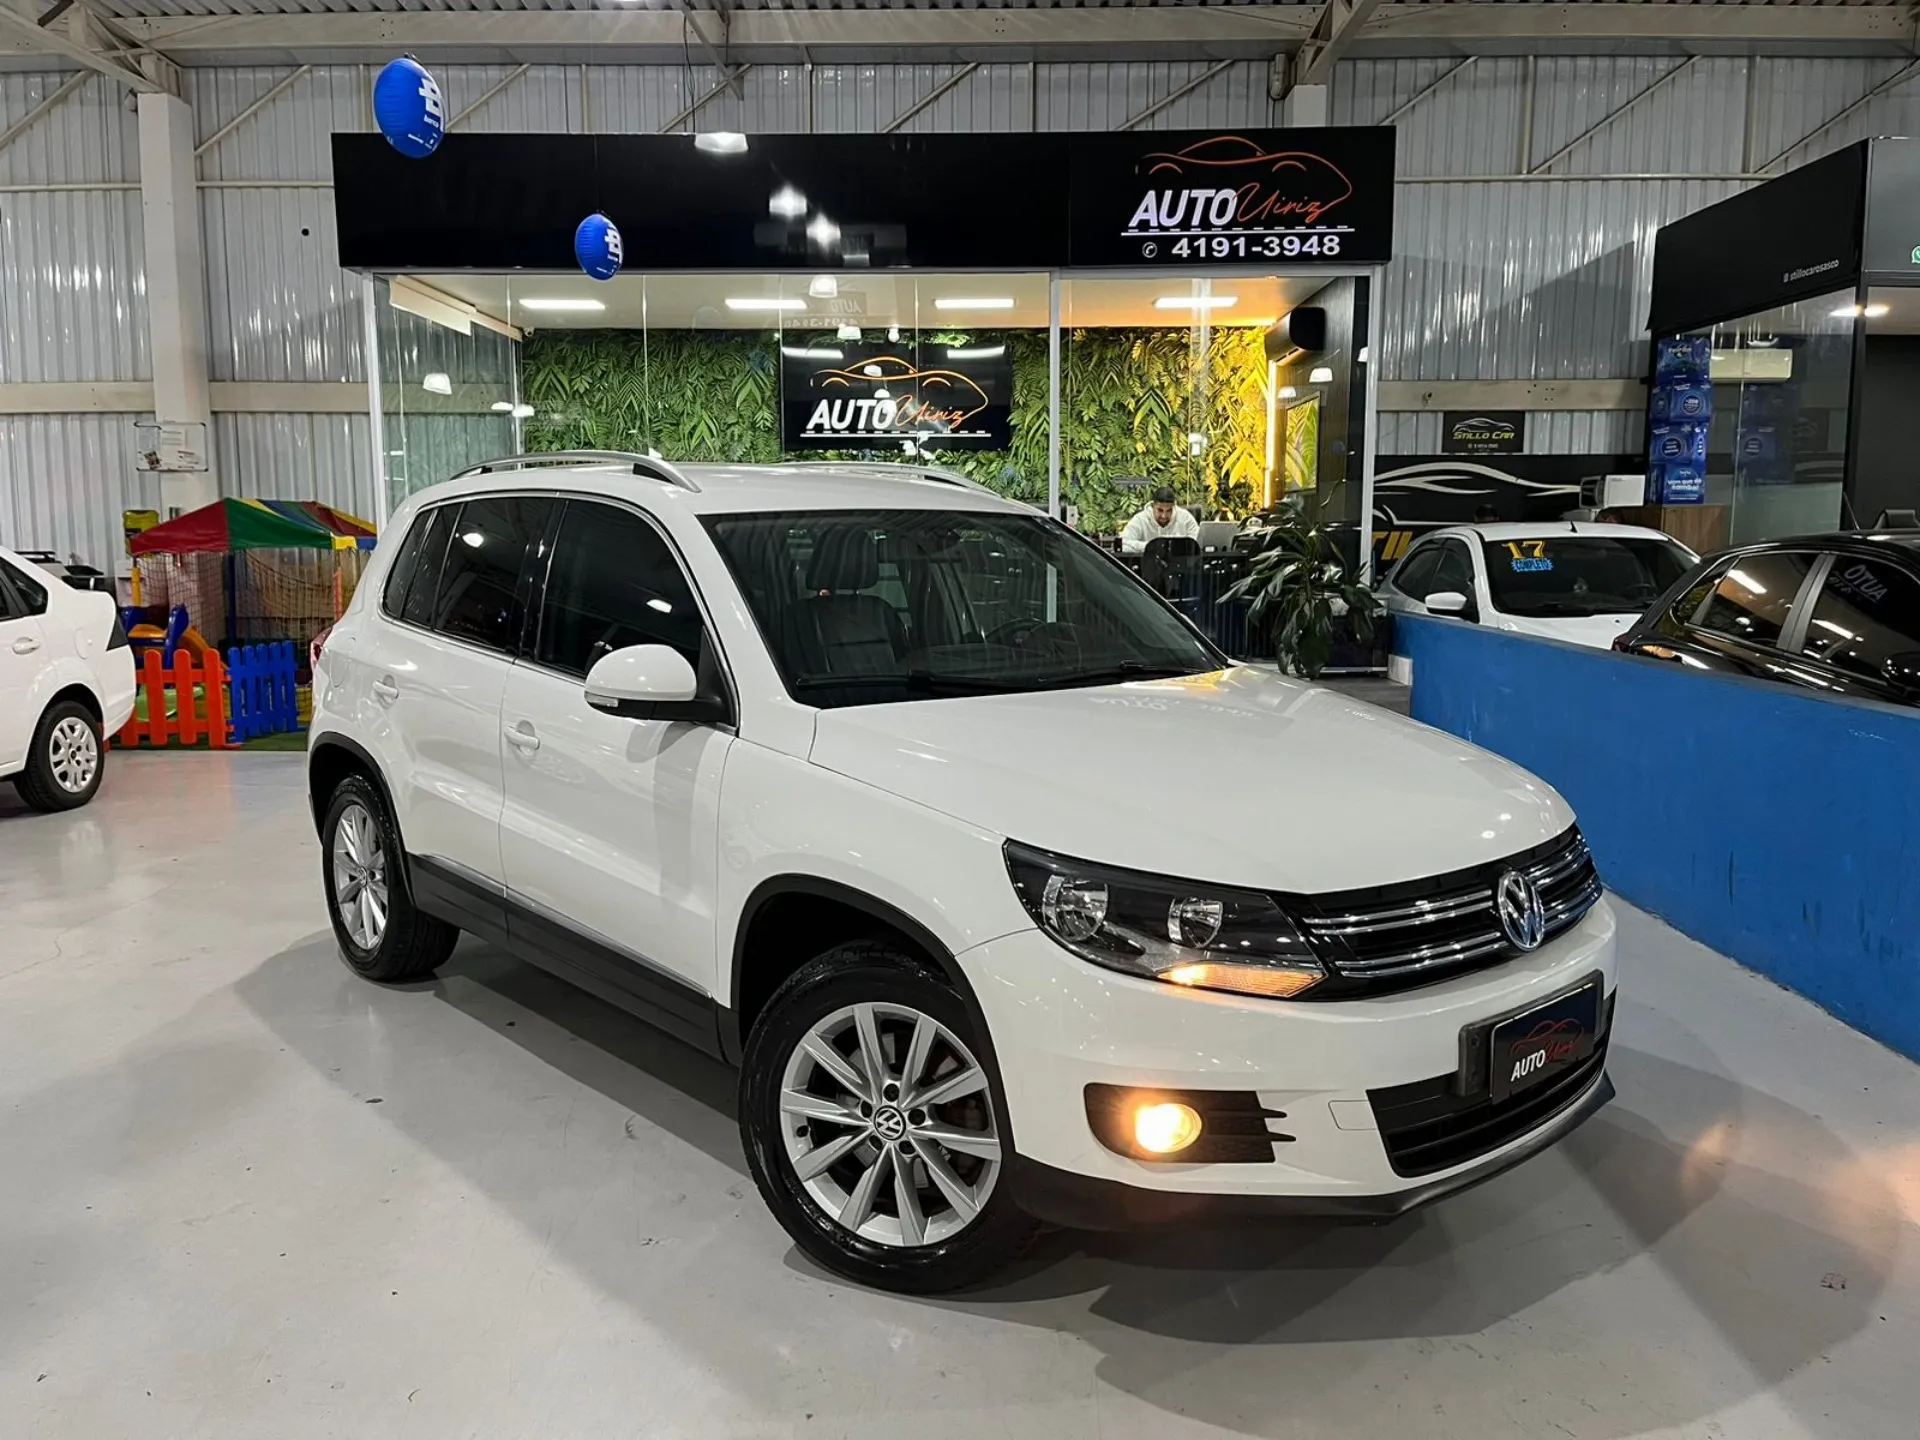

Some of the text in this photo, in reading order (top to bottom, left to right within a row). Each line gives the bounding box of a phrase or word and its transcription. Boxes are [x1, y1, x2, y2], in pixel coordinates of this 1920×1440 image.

[1128, 188, 1238, 227] AUTO
[1171, 235, 1341, 258] 4191-3948
[805, 399, 897, 430] AUTO
[1501, 541, 1545, 558] 17
[1510, 1049, 1546, 1082] AUTO
